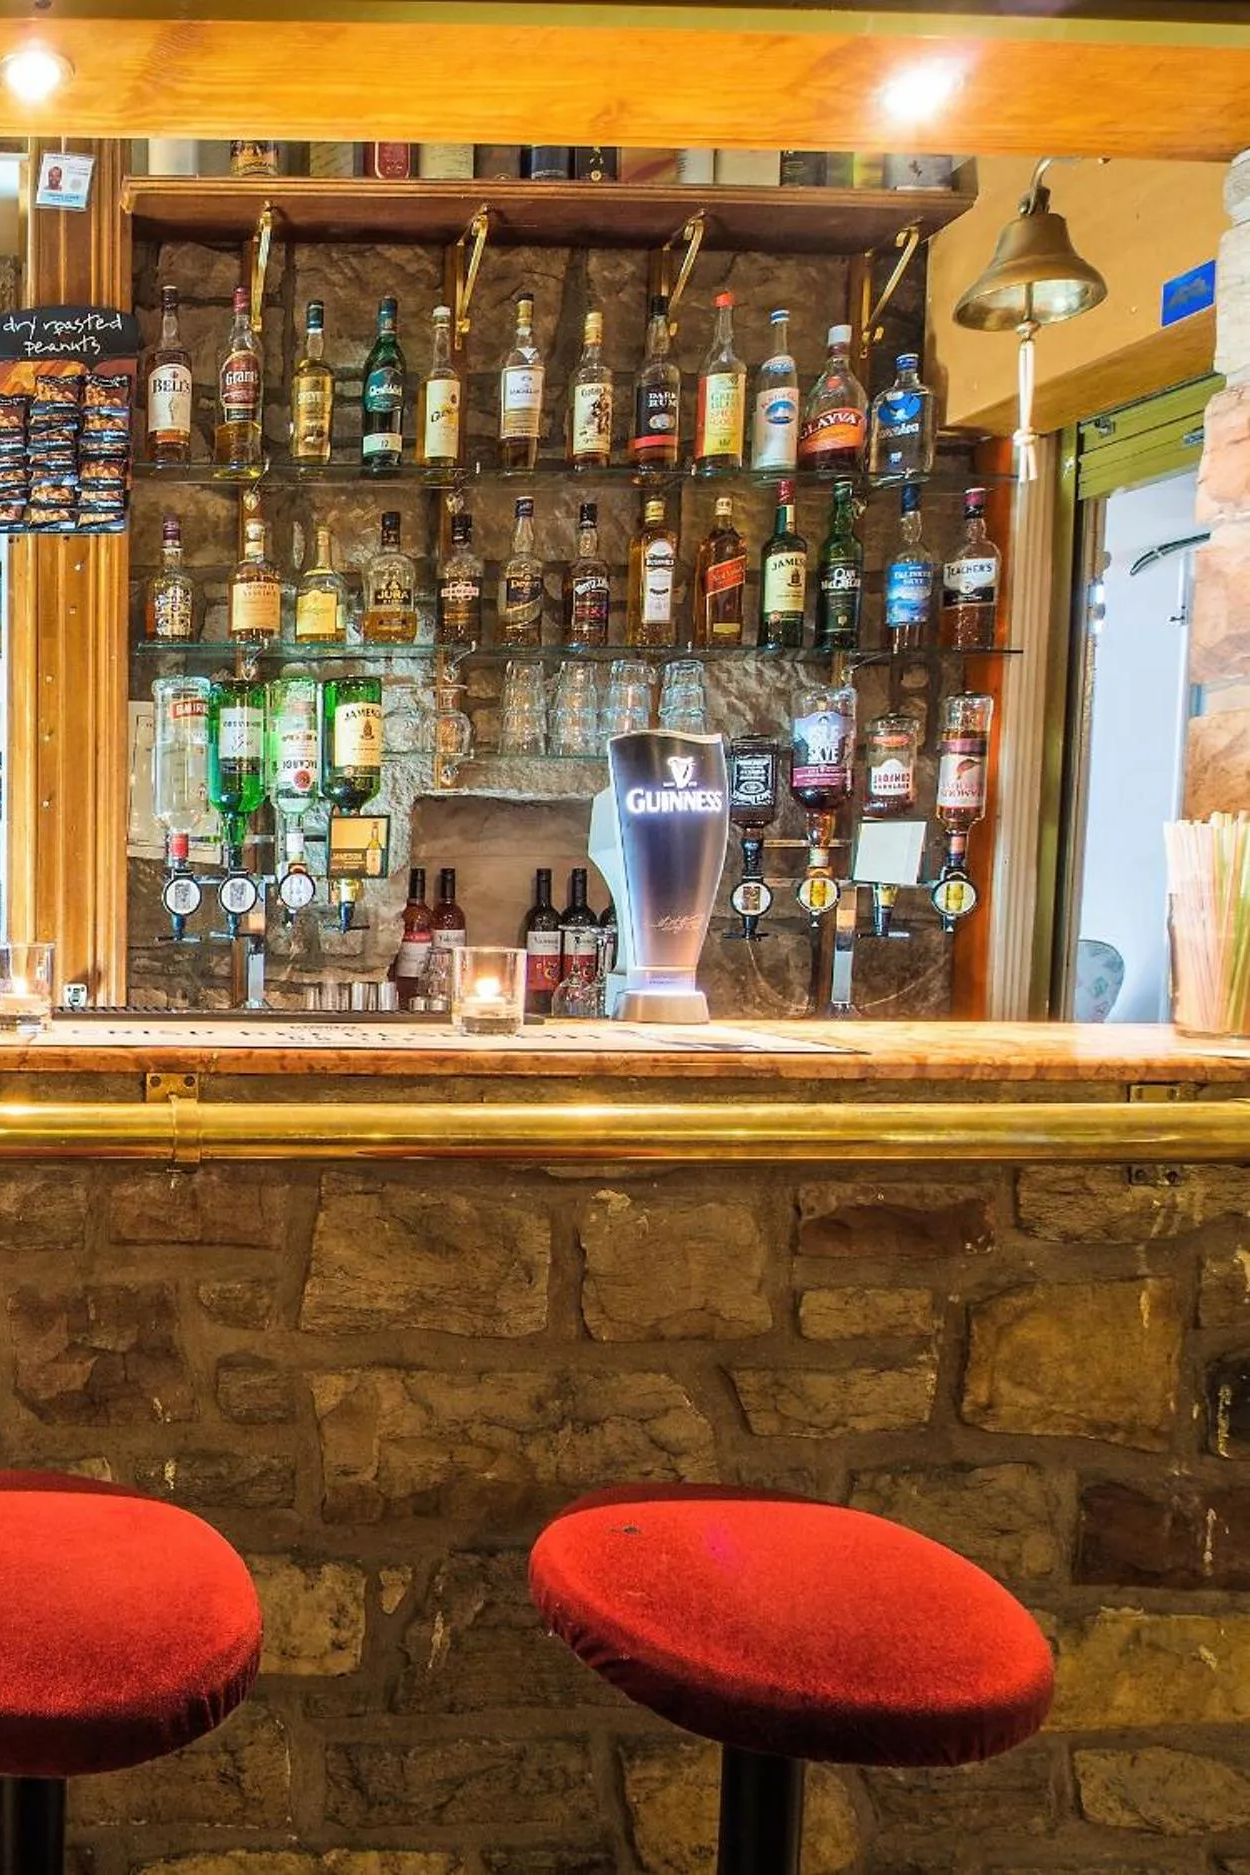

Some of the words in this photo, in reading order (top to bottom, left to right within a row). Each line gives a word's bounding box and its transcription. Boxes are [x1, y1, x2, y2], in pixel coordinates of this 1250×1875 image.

[2, 315, 37, 340] dry
[42, 313, 124, 336] roasted
[22, 334, 100, 357] peanuts
[377, 591, 409, 600] JURA
[626, 788, 723, 814] GUINNESS
